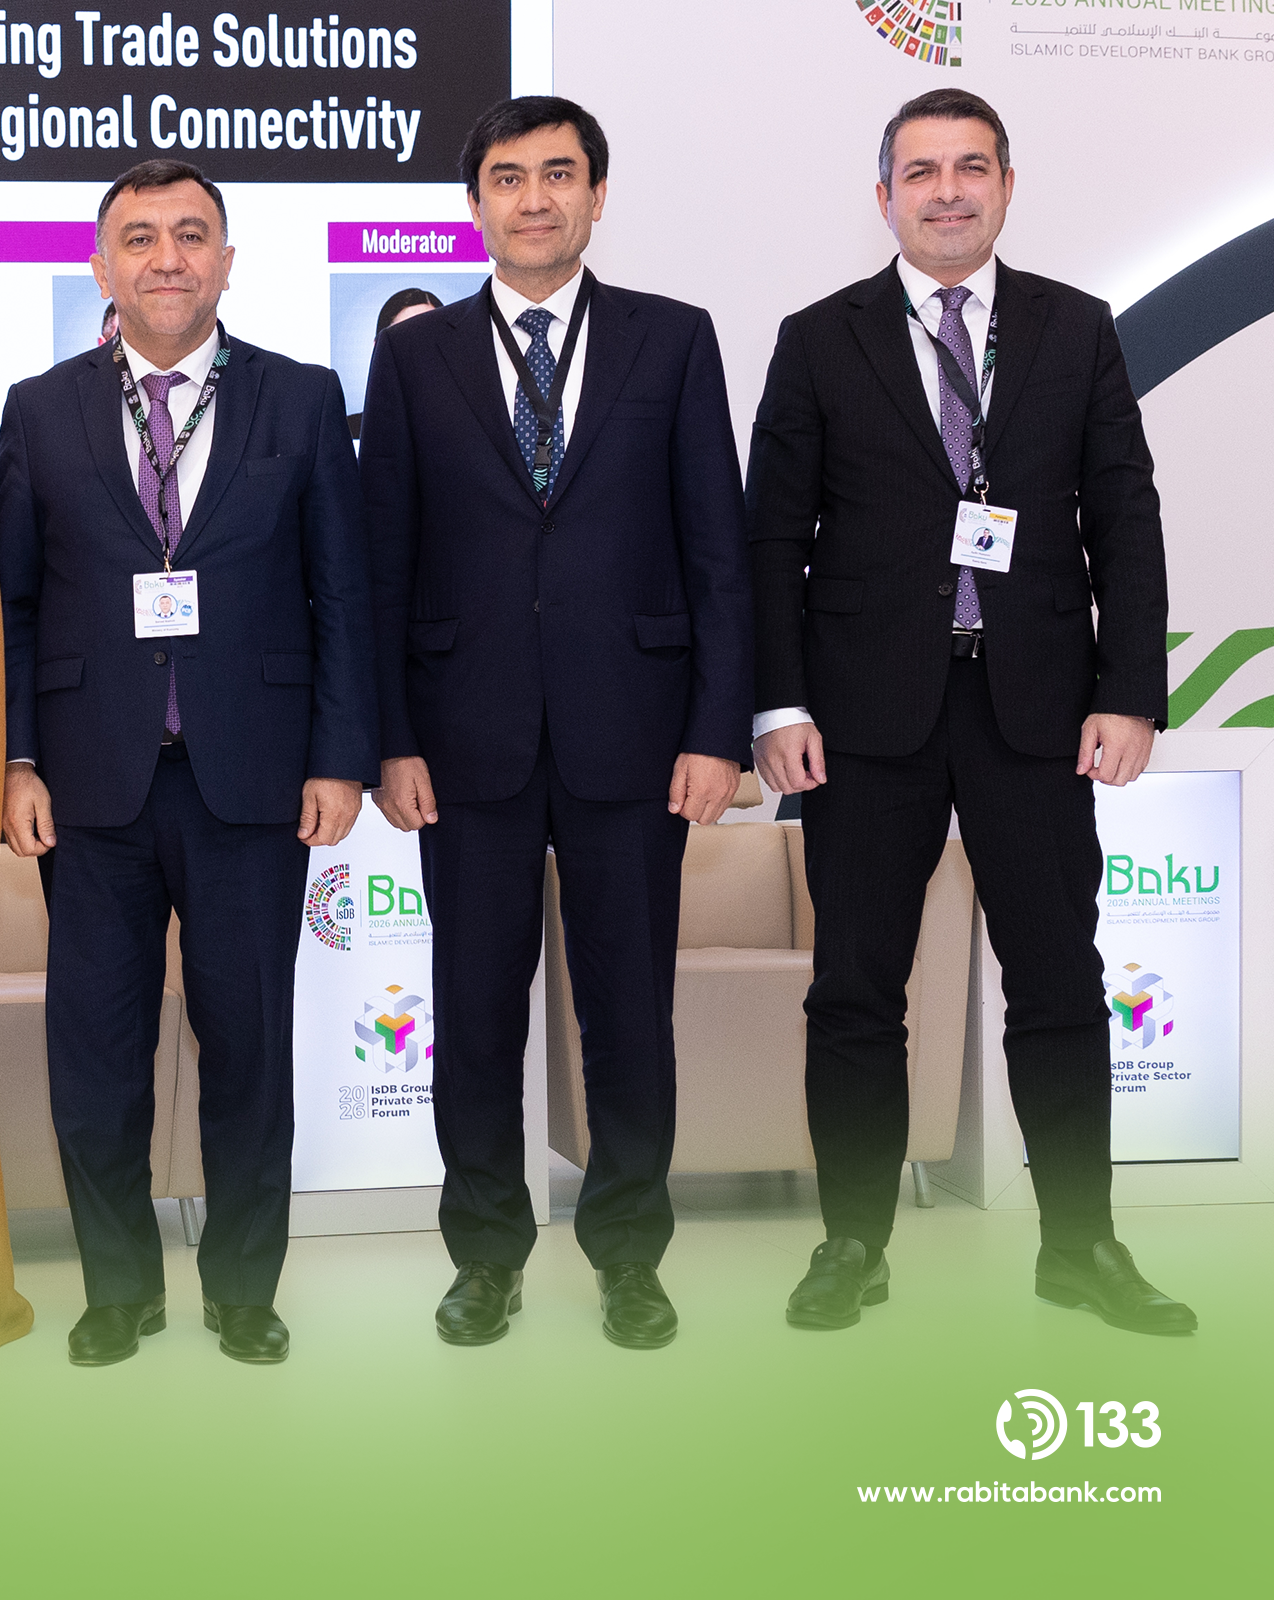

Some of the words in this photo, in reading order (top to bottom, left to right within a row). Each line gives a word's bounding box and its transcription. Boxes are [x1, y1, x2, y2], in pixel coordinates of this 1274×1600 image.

[75, 11, 199, 67] Trade
[213, 12, 418, 69] Solutions
[1011, 43, 1074, 56] ISLAMIC
[1079, 44, 1193, 59] DEVELOPMENT
[1198, 48, 1240, 61] BANK
[150, 94, 421, 163] Connectivity
[362, 228, 457, 254] Moderator
[1107, 853, 1219, 896] Baku
[1107, 898, 1129, 907] 2026
[1131, 898, 1170, 906] ANNUAL
[1172, 896, 1220, 905] MEETINGS
[336, 908, 355, 920] IsDB
[368, 920, 390, 928] 2026
[393, 918, 431, 927] ANNUAL
[1137, 1060, 1174, 1071] Group
[1153, 1071, 1192, 1080] Sector
[339, 1085, 365, 1103] 20
[371, 1084, 398, 1094] IsDB
[371, 1096, 413, 1106] Private
[416, 1095, 433, 1105] Se
[339, 1102, 366, 1120] 26
[371, 1108, 410, 1118] Forum
